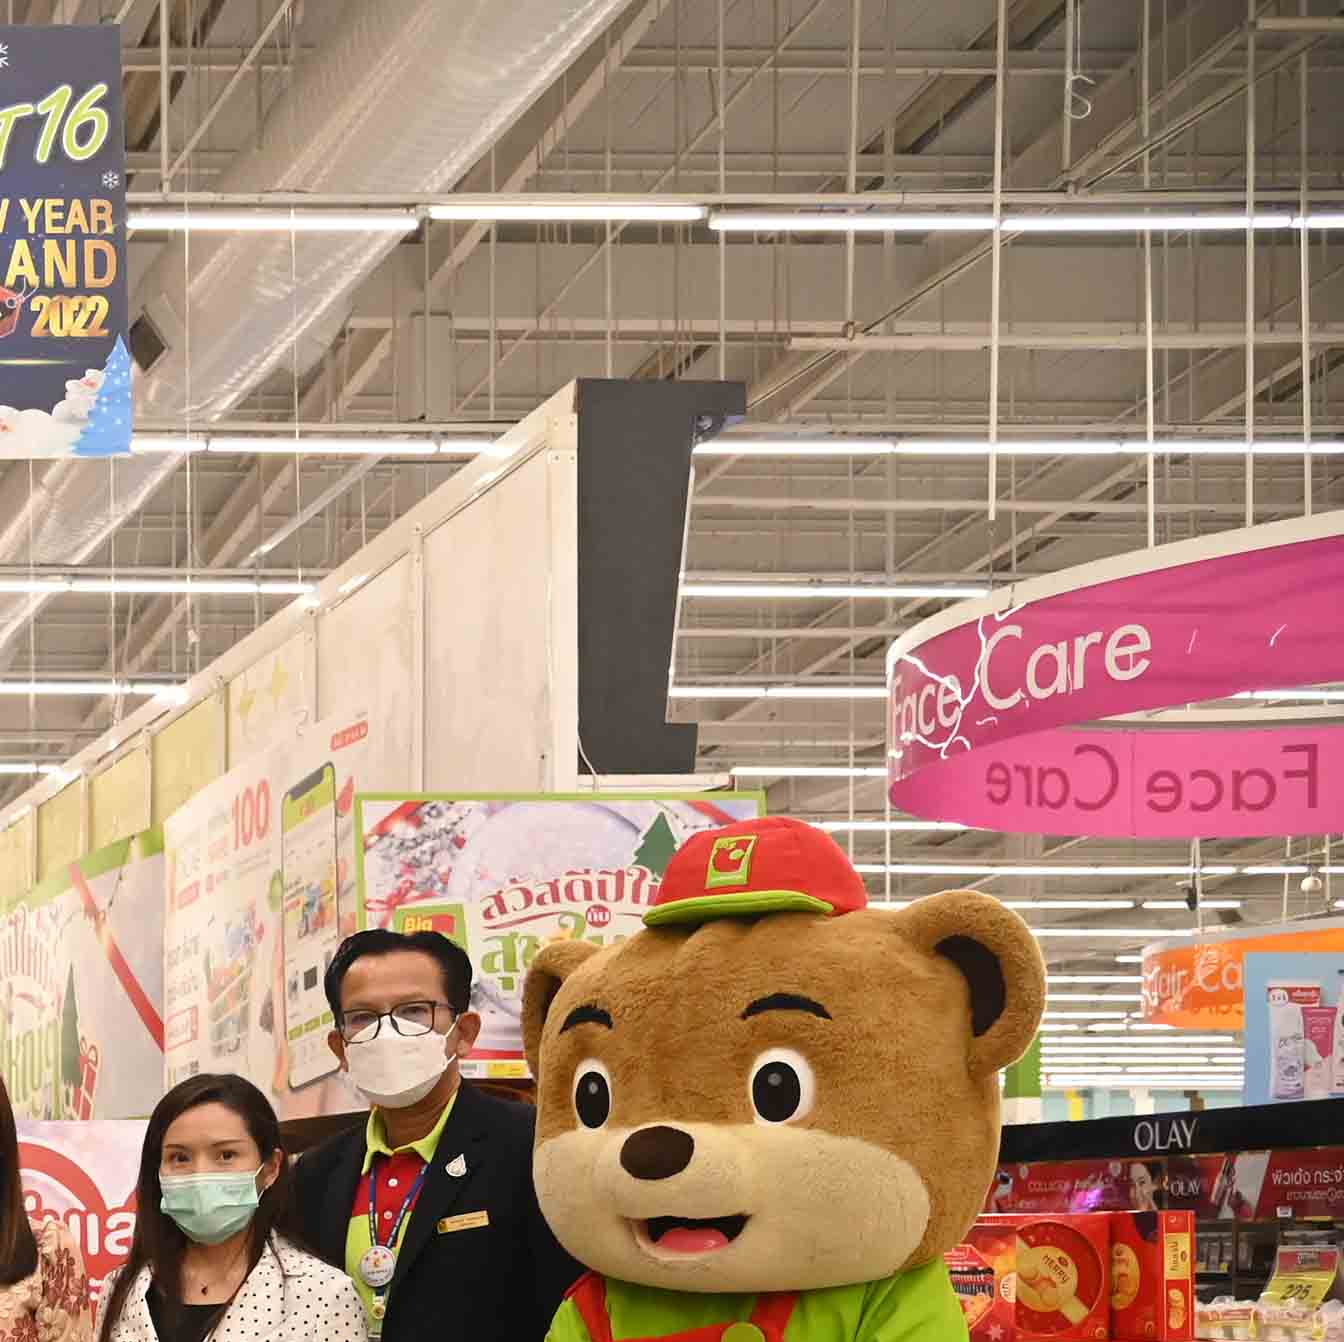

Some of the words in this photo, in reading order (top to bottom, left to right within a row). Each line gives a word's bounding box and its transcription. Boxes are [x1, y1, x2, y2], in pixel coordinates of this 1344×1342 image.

[35, 83, 109, 164] 16
[18, 198, 114, 235] YEAR
[30, 296, 110, 337] 2022
[978, 622, 1153, 711] Care
[232, 778, 272, 850] 100
[1134, 1119, 1199, 1151] OLAY
[1170, 1177, 1201, 1196] OLAY
